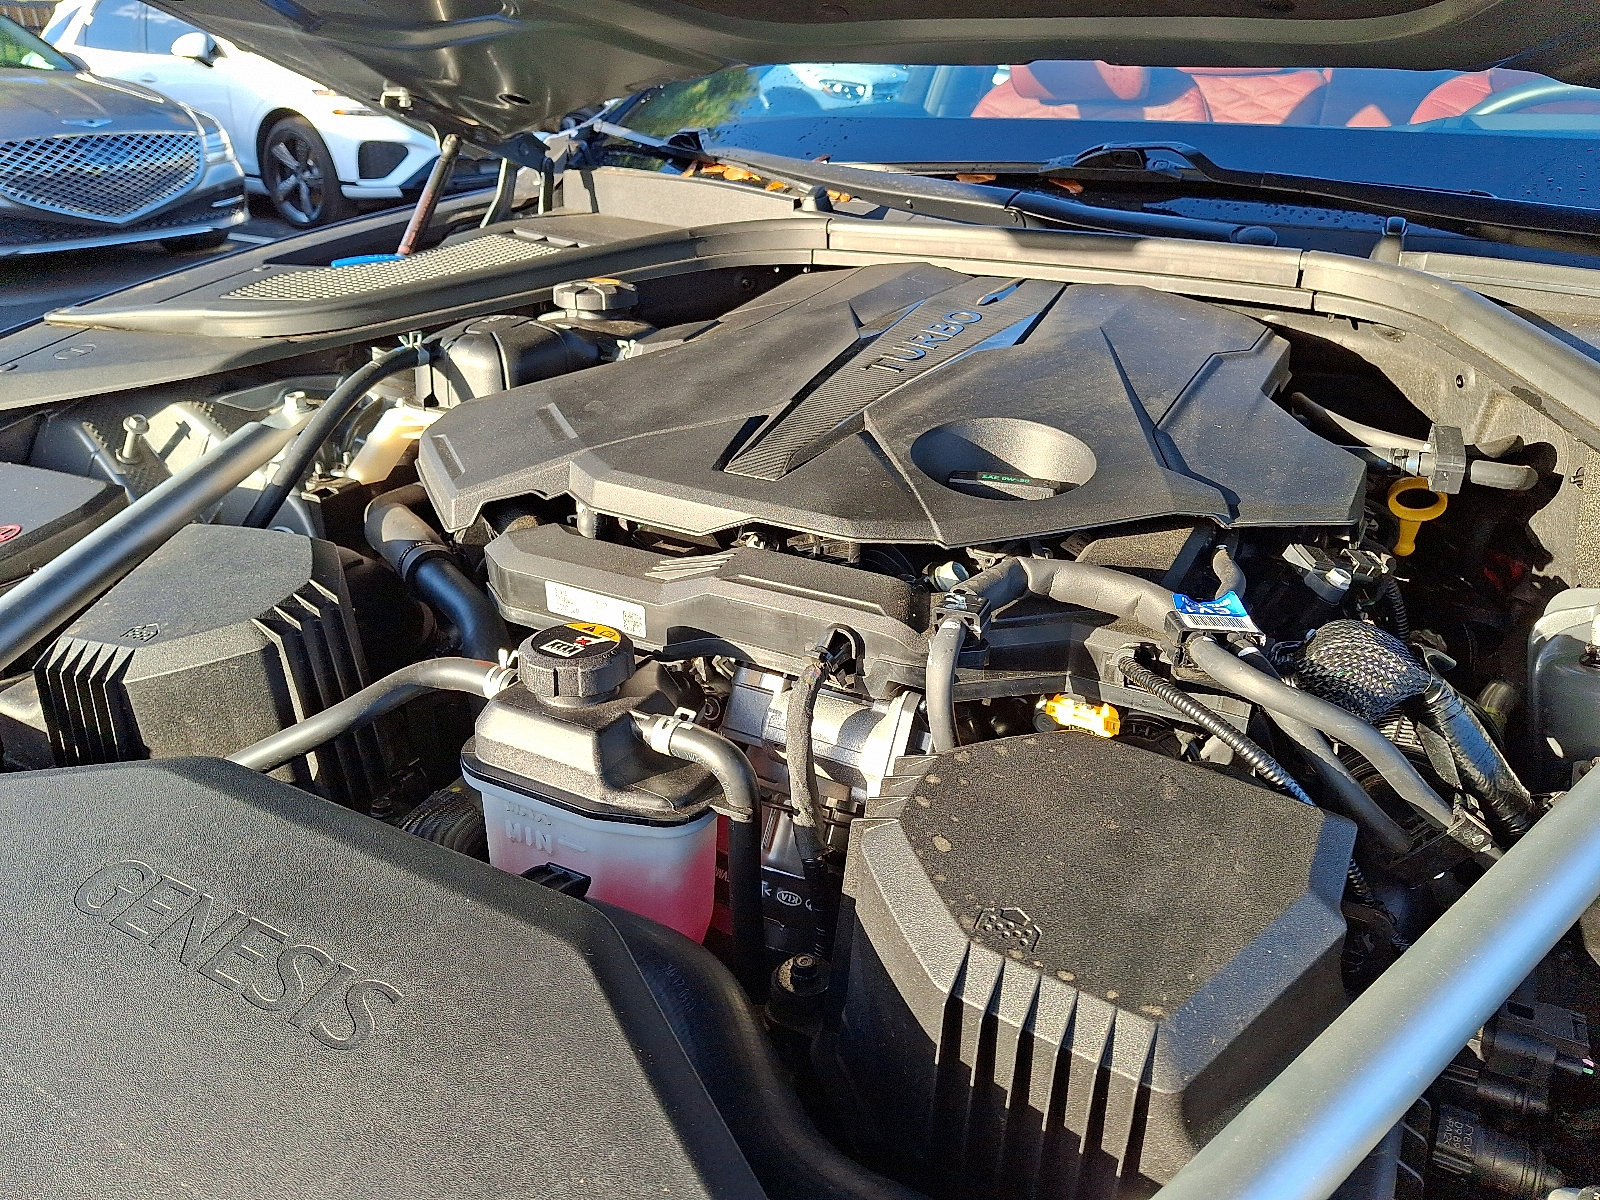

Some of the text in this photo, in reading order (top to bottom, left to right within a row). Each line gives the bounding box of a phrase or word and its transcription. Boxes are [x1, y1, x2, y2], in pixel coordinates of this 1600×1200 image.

[859, 309, 983, 374] TURBO
[981, 473, 1000, 481] SAE
[504, 819, 554, 856] MIN
[779, 892, 801, 906] KIA
[73, 859, 403, 1051] GENESIS
